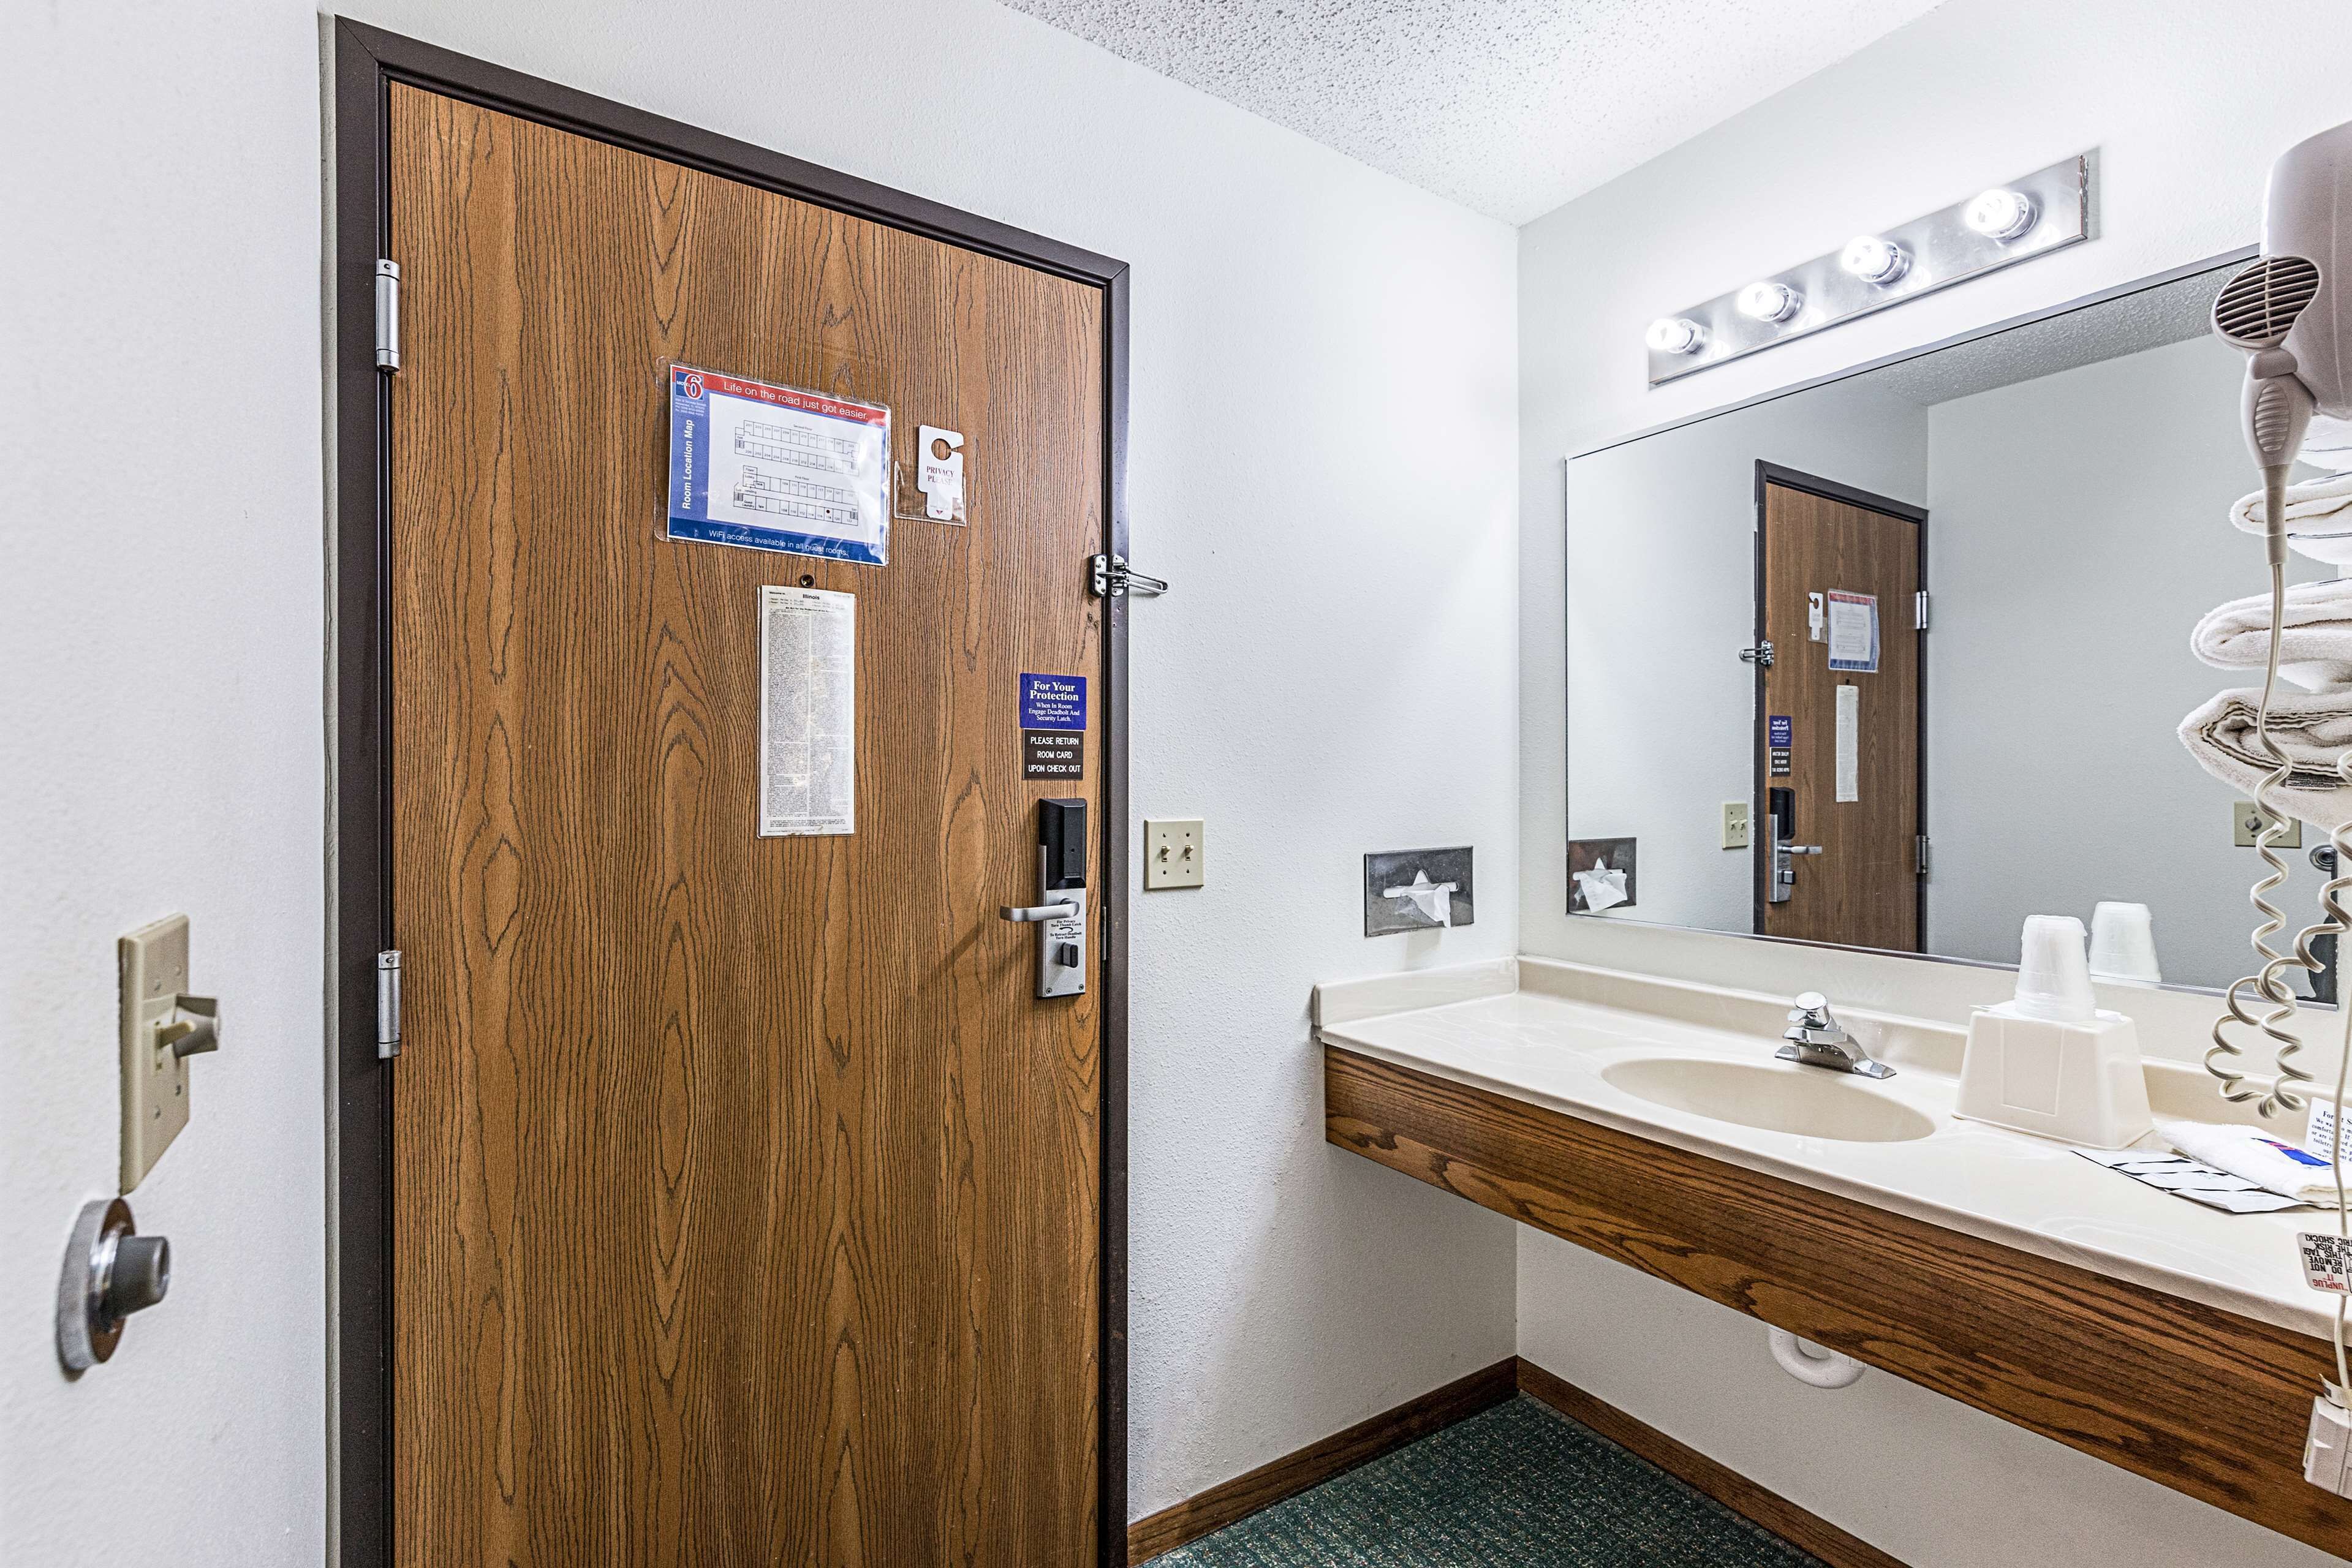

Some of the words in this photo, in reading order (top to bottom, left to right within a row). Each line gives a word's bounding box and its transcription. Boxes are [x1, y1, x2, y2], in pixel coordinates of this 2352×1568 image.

[684, 374, 702, 399] 6
[724, 382, 742, 393] Life
[745, 387, 757, 396] on
[761, 390, 775, 399] the
[778, 394, 800, 405] road
[803, 398, 819, 409] just
[822, 404, 837, 414] got
[839, 408, 868, 420] easier.
[684, 420, 695, 439] Map
[683, 441, 692, 480] Location
[926, 466, 955, 478] PRIVACY
[682, 482, 691, 509] Room
[709, 530, 724, 538] WiFi
[727, 533, 752, 543] access
[755, 538, 786, 547] available
[805, 545, 825, 553] guest
[1034, 680, 1050, 690] For
[1052, 682, 1075, 692] Your
[1030, 690, 1078, 701] Protection
[1030, 736, 1054, 745] PLEASE
[2305, 1234, 2335, 1245] SHOCK!
[2314, 1242, 2333, 1251] RISK
[2335, 1245, 2350, 1253] THE
[2324, 1251, 2343, 1259] THIS
[2308, 1256, 2343, 1267] REMOVE
[2310, 1264, 2326, 1272] NOT
